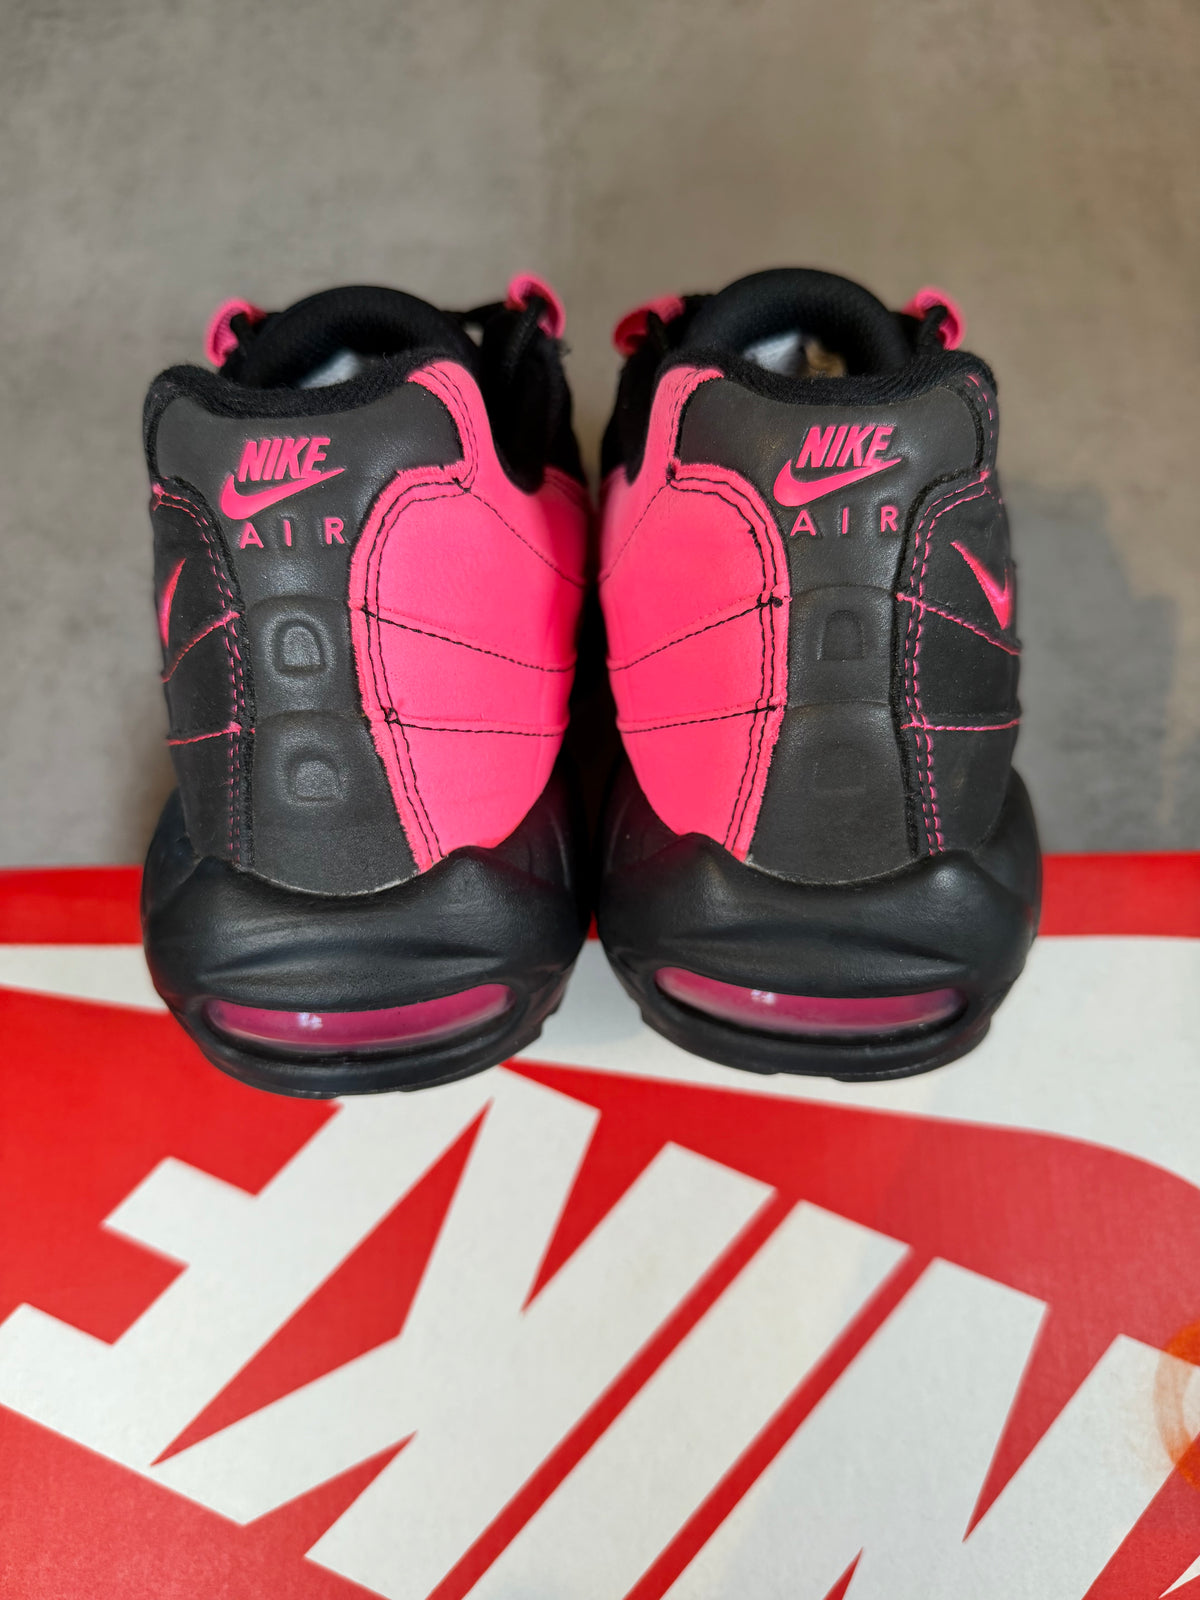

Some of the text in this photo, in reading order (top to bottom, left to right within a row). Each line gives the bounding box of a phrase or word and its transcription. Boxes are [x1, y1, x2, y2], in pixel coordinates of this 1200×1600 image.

[238, 436, 331, 482] NIKE
[795, 424, 894, 469] NIKE
[239, 517, 345, 549] AIR
[789, 505, 899, 537] AIR
[0, 1062, 1200, 1600] NIKE
